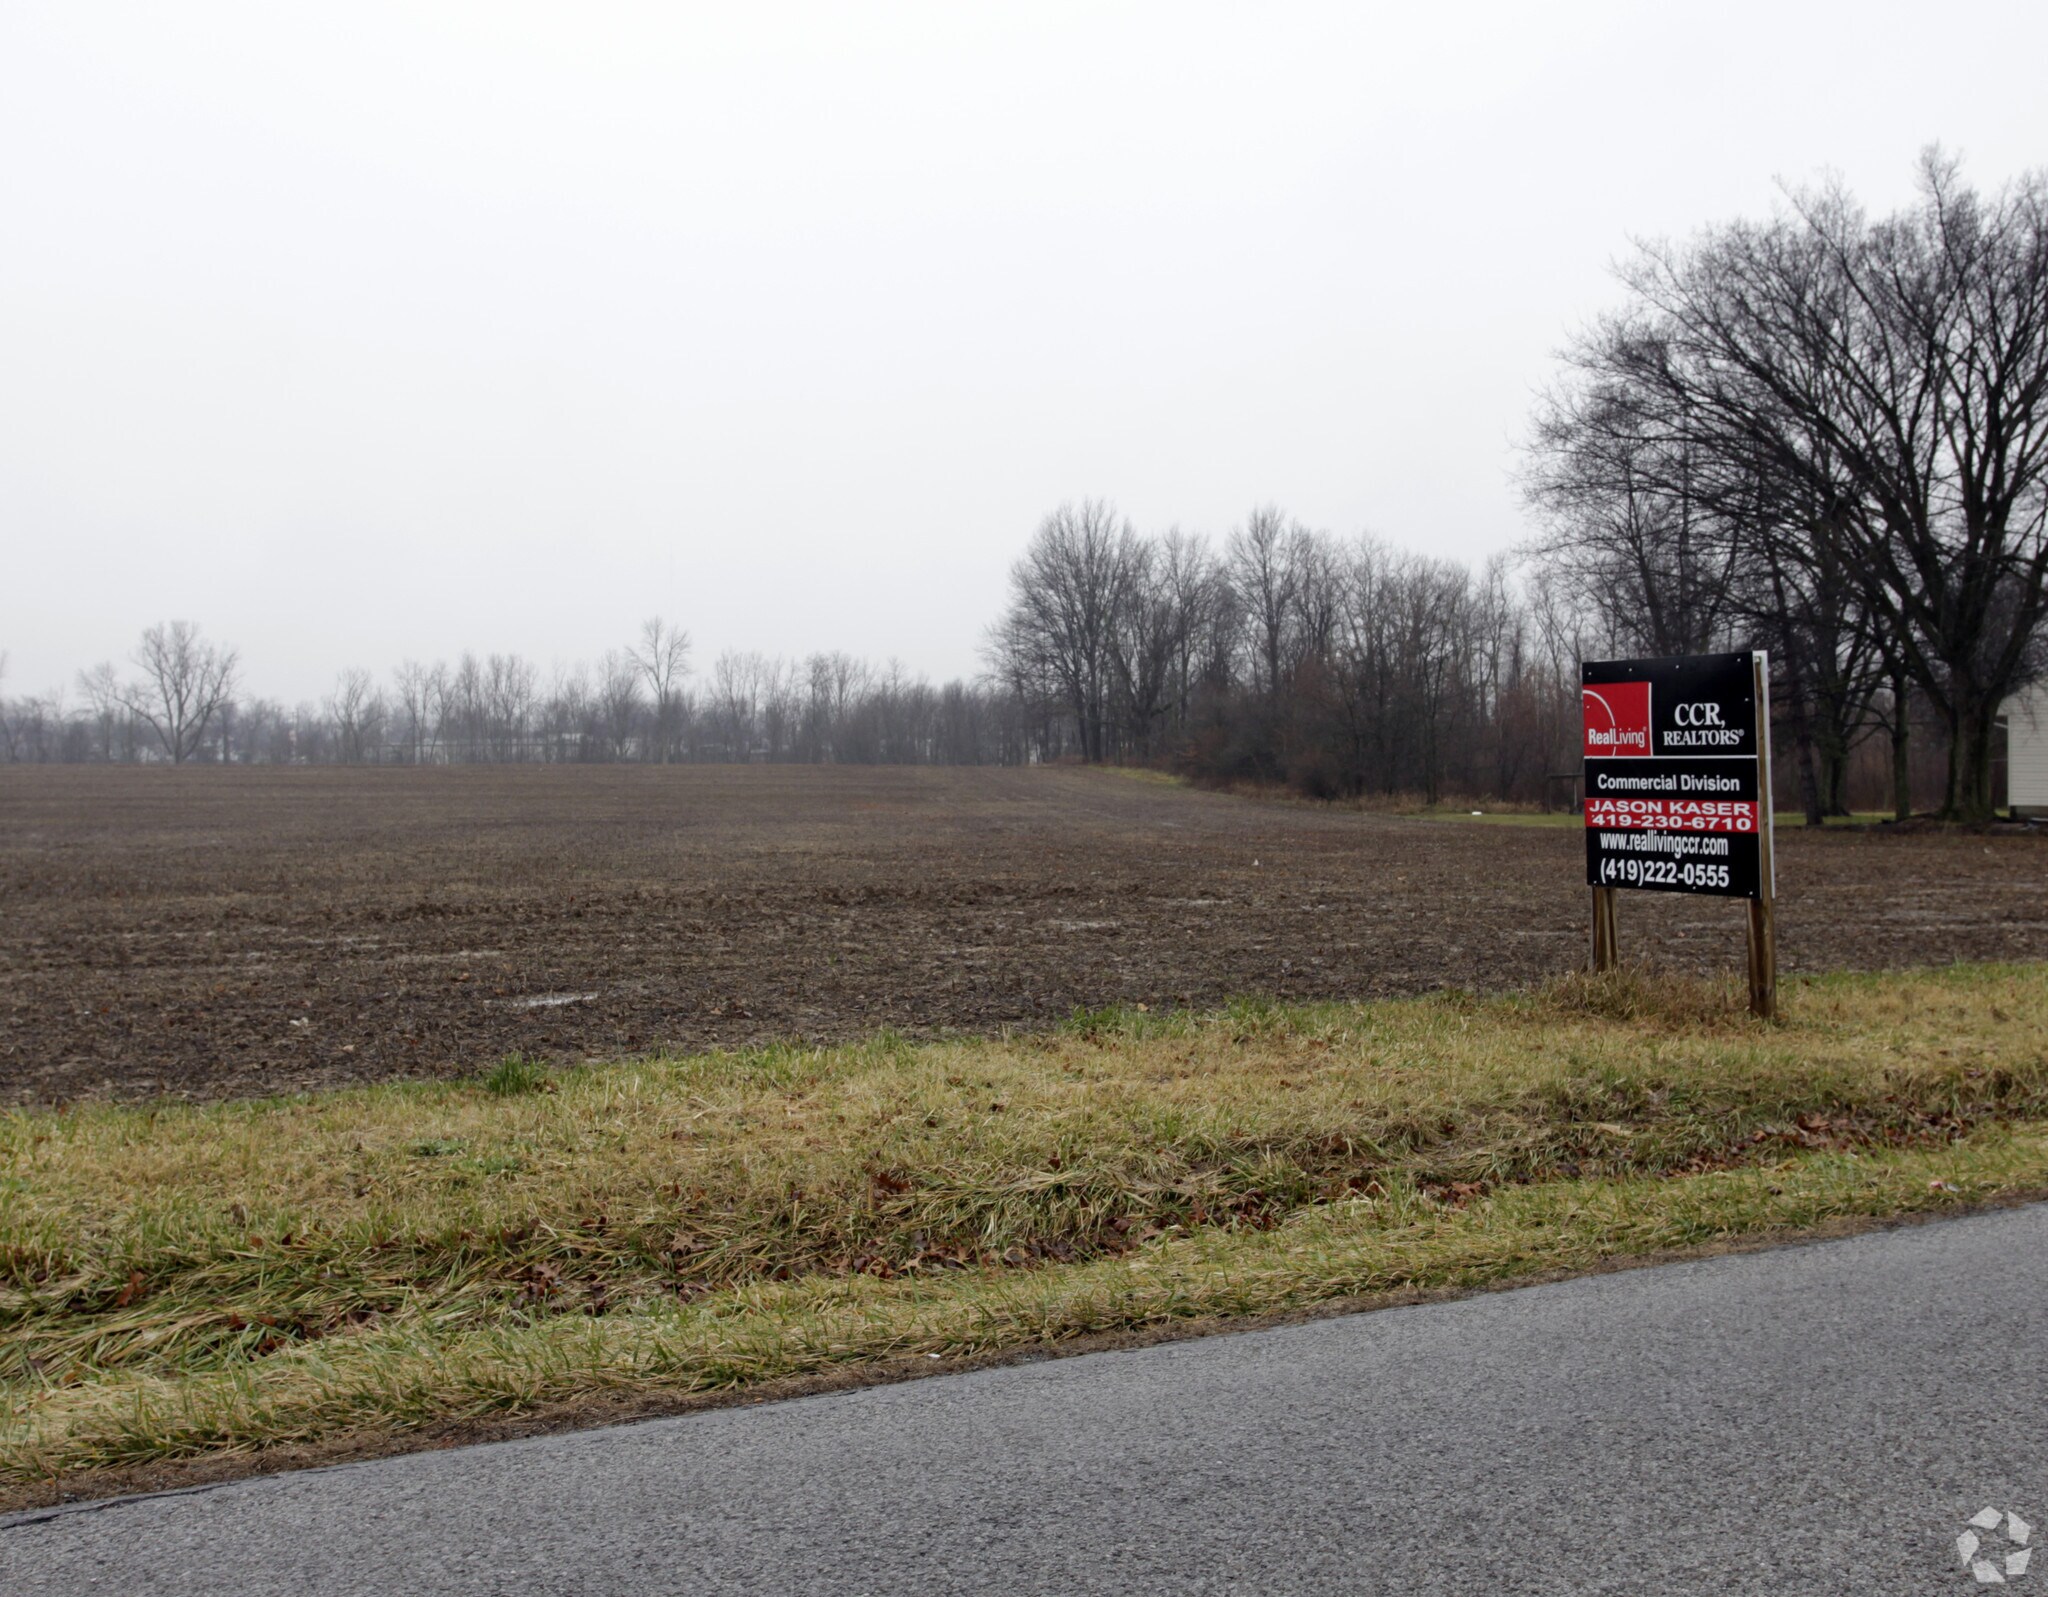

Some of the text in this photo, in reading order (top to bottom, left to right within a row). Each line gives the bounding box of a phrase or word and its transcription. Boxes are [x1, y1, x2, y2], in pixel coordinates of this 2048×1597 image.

[1597, 773, 1740, 791] Commercial Division
[1589, 800, 1751, 816] JASON KASER
[1592, 814, 1751, 830] 419-230-6710
[1600, 830, 1728, 858] www.reallivingccr.com
[1600, 858, 1729, 887] (419)222-0555
